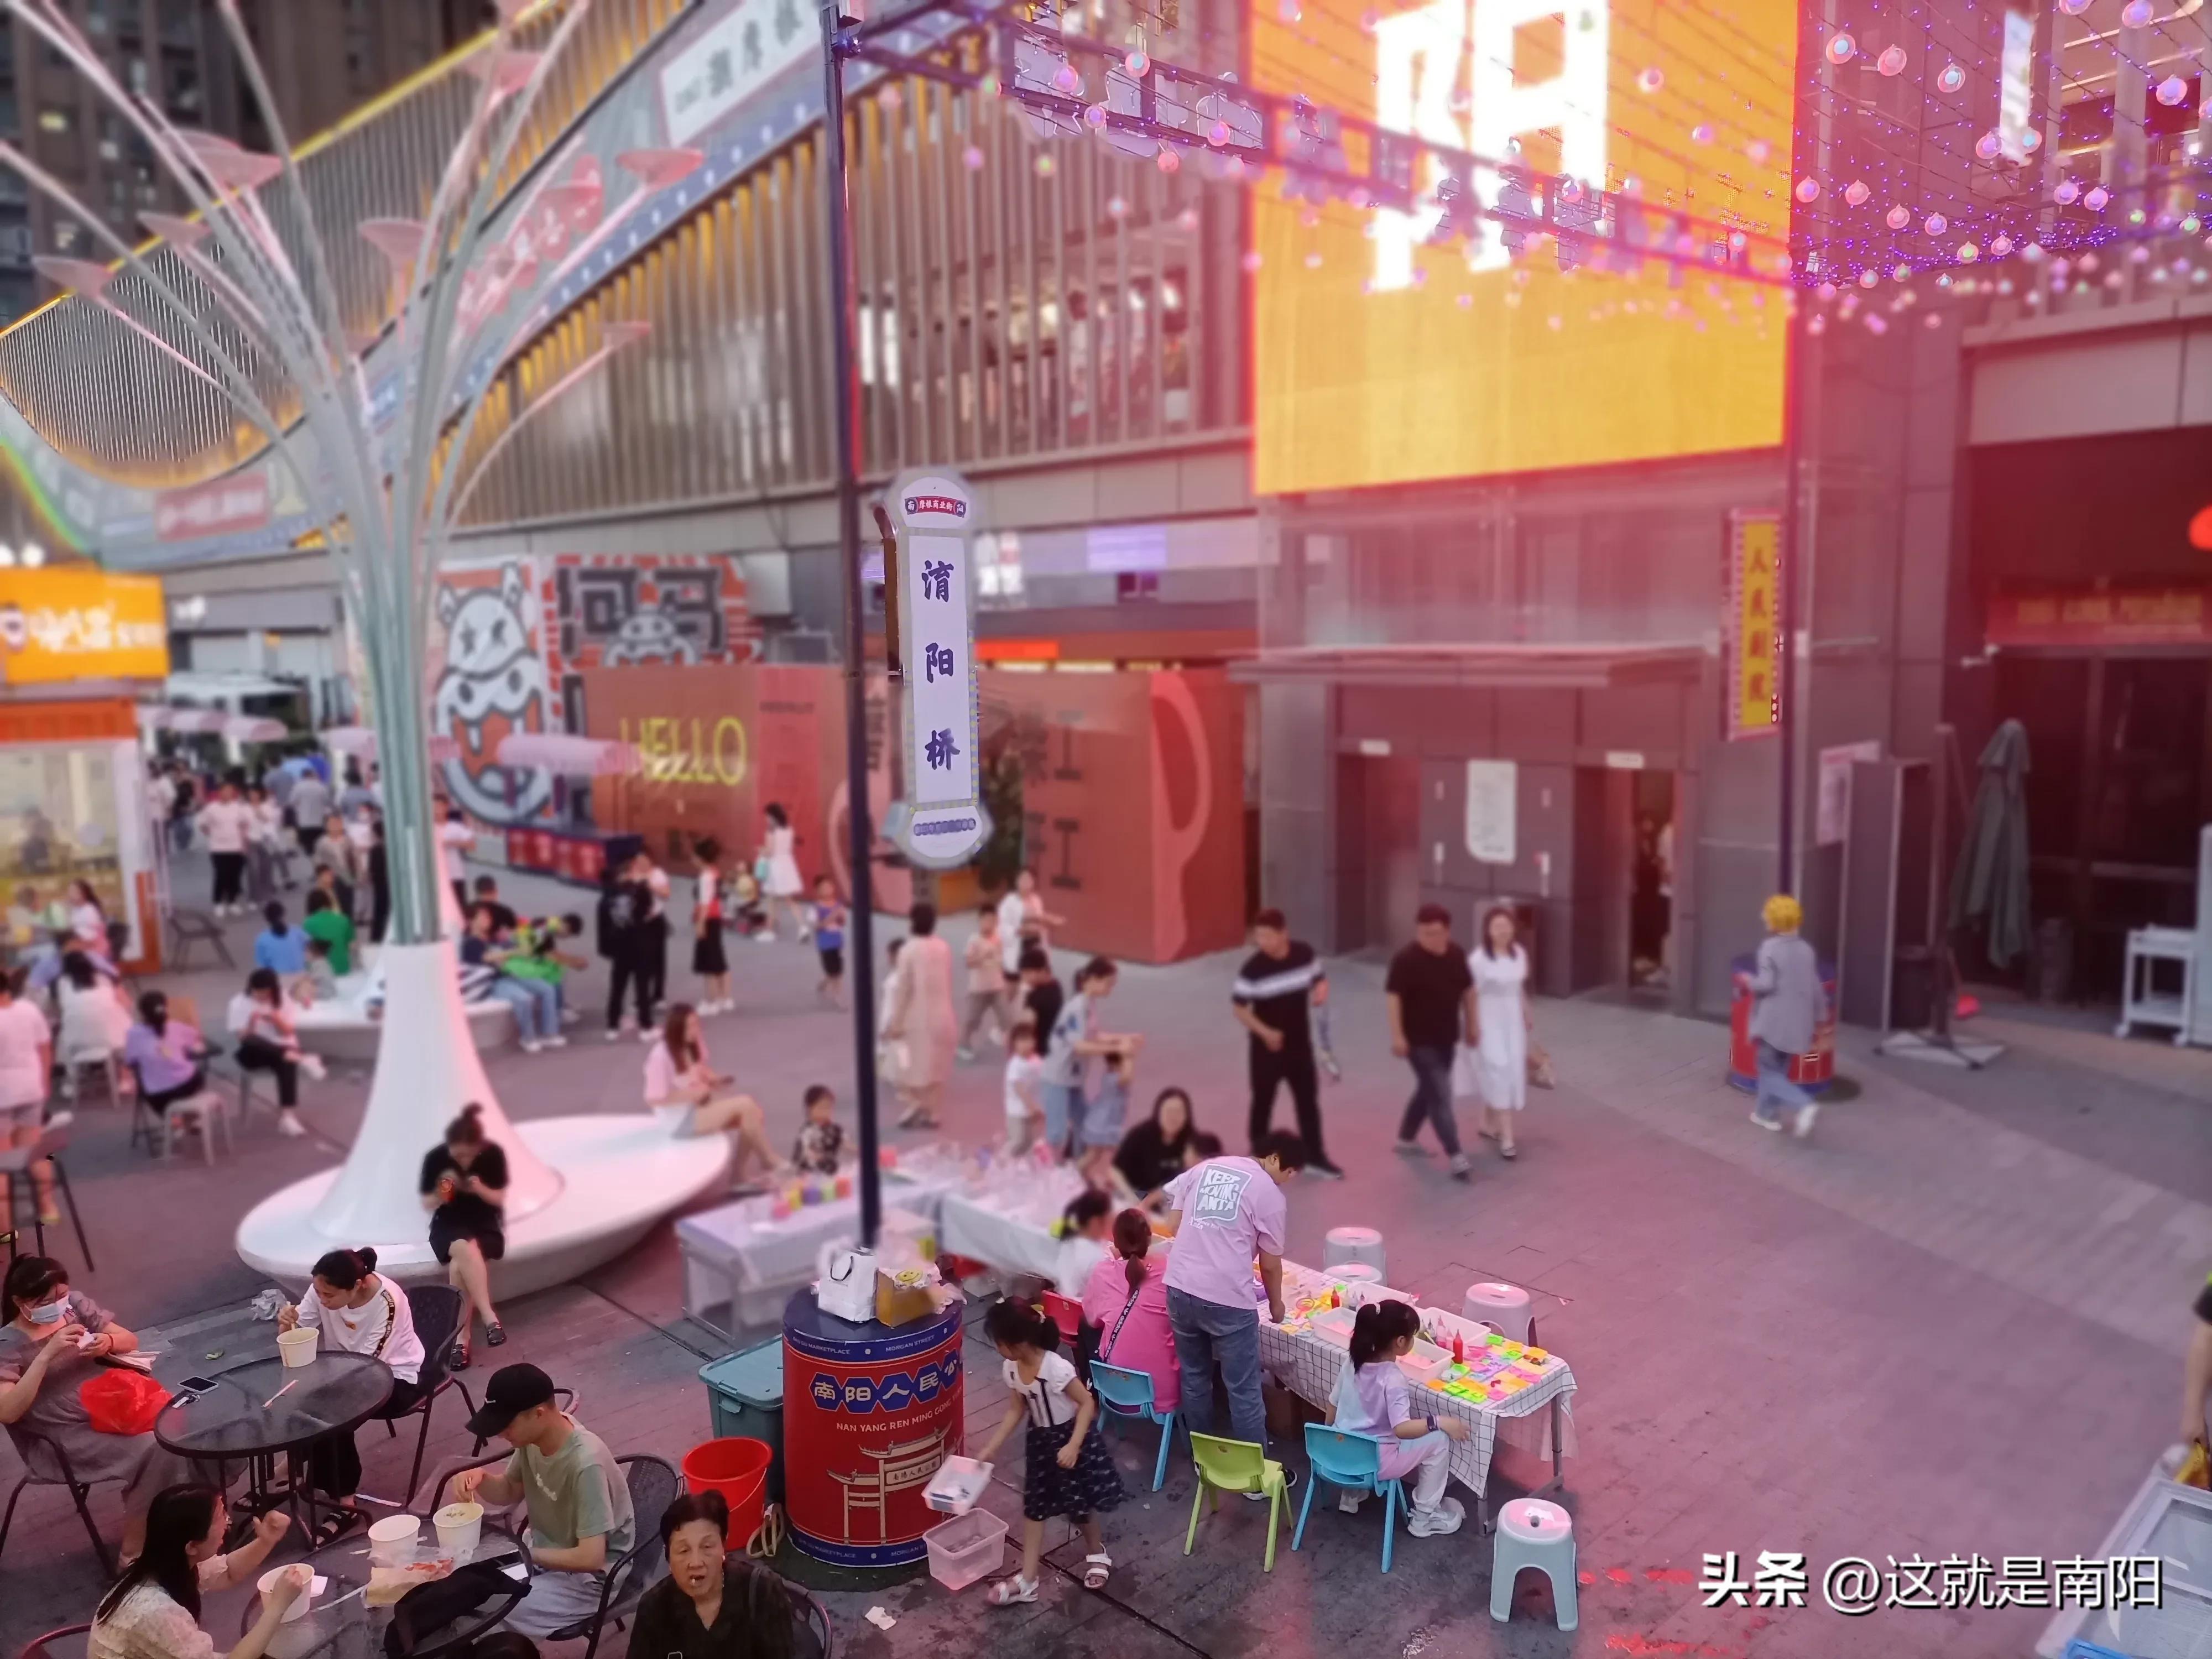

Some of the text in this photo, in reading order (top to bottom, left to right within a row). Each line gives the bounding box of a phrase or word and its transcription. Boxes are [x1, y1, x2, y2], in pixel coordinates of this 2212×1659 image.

[620, 716, 748, 786] HELLO
[1203, 1168, 1241, 1186] KEEP
[1199, 1183, 1240, 1202] MOVING
[1197, 1194, 1234, 1211] ANTA
[808, 1343, 851, 1354] MARKETPLACE
[886, 1334, 935, 1352] MORGAN STREET
[814, 1359, 961, 1401] 南阳人民公
[836, 1422, 857, 1432] NAN
[860, 1423, 886, 1432] YANG
[890, 1419, 909, 1430] REN
[912, 1410, 933, 1425] MING
